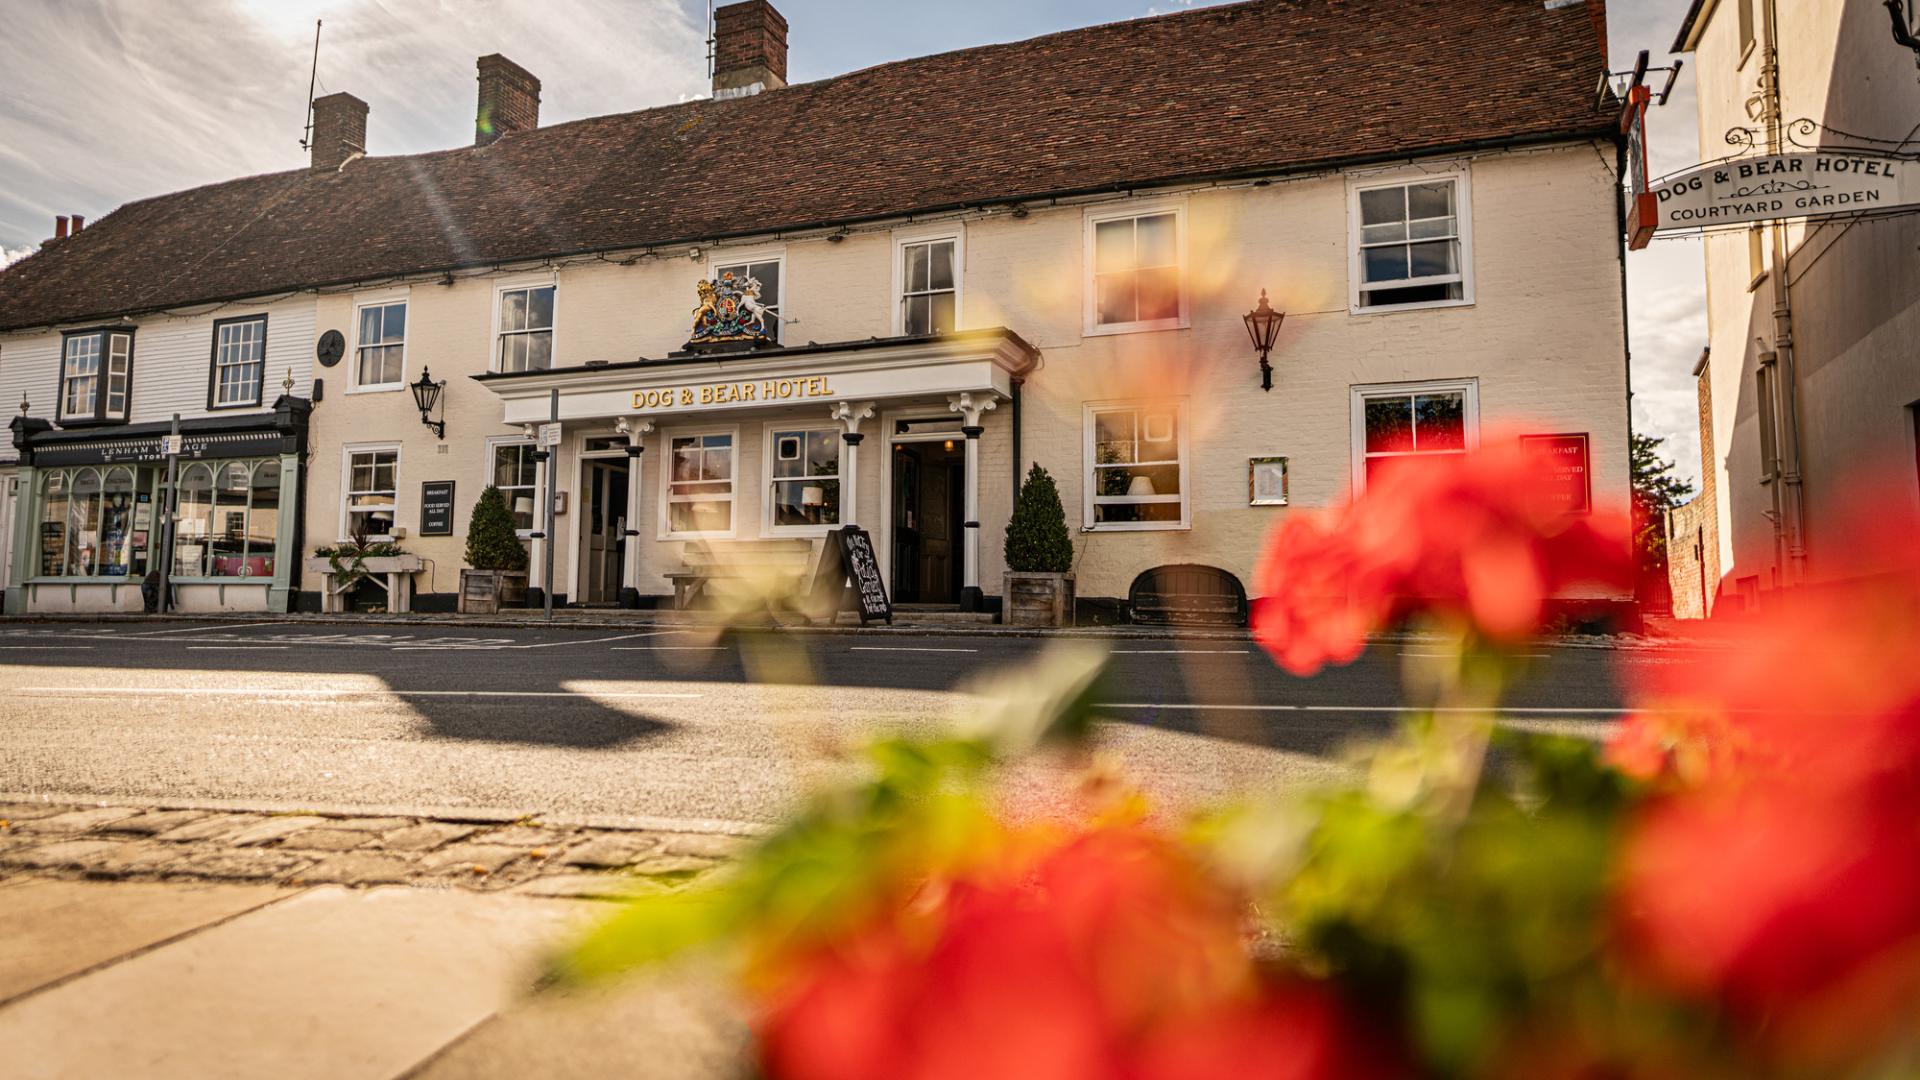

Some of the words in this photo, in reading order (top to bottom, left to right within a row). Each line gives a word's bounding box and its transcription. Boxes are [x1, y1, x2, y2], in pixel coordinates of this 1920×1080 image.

[1657, 177, 1702, 202] DOG
[1714, 171, 1729, 184] &
[1739, 159, 1803, 178] BEAR
[1815, 158, 1895, 178] HOTEL
[1670, 200, 1783, 221] COURTYARD
[1795, 190, 1879, 208] GARDEN
[632, 389, 673, 409] DOG
[680, 387, 694, 405] &
[700, 383, 755, 404] BEAR
[762, 376, 834, 400] HOTEL
[101, 446, 149, 456] LENHAM
